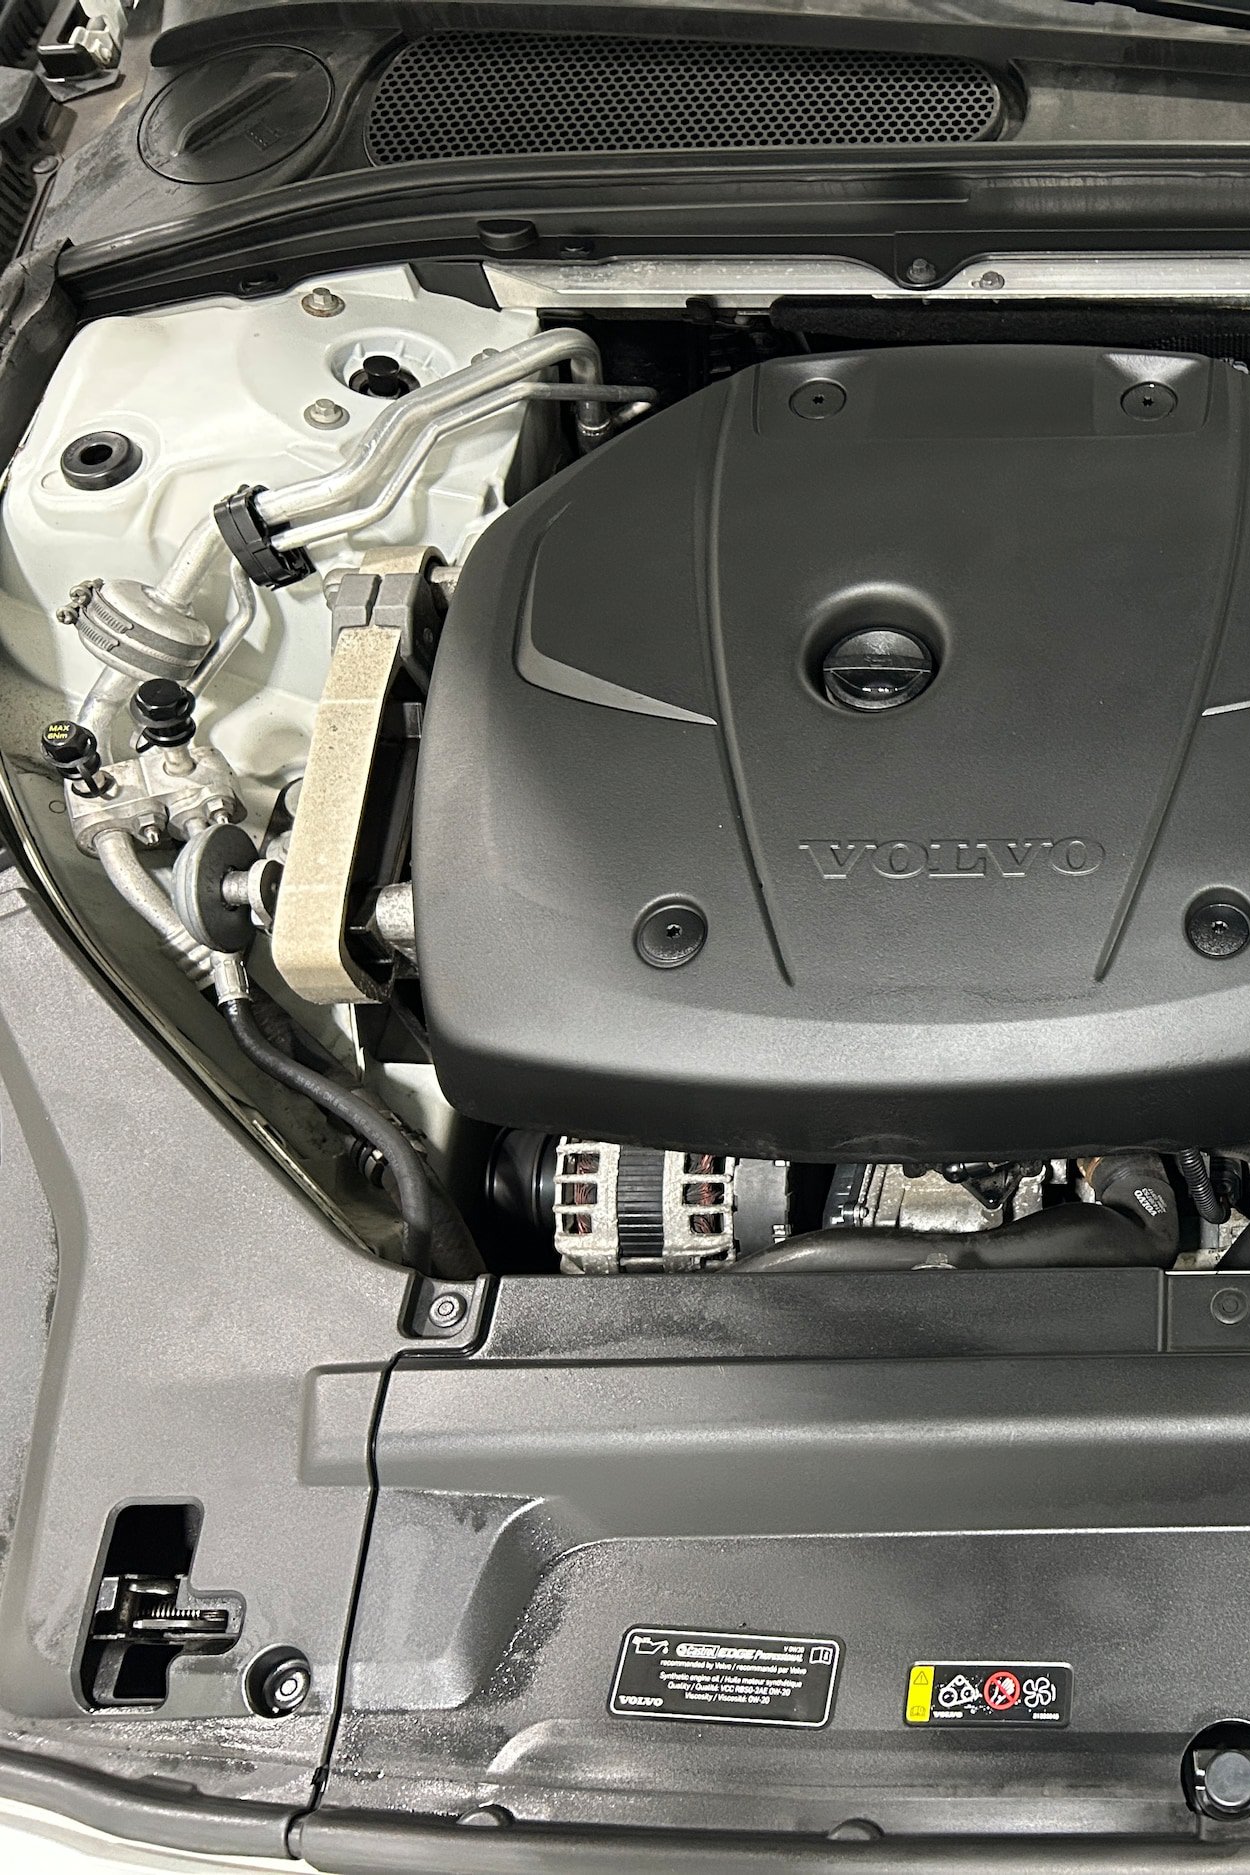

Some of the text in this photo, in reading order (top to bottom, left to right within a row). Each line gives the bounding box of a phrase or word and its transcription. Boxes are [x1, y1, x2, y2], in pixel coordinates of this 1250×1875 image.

[799, 837, 1106, 879] VOLVO
[1134, 1190, 1157, 1216] VOLVO
[686, 1645, 717, 1657] Castrol
[717, 1647, 757, 1659] EDGE
[660, 1659, 706, 1669] recommended
[706, 1662, 714, 1671] by
[714, 1662, 732, 1670] Volvo
[777, 1667, 789, 1675] par
[789, 1667, 807, 1675] Volvo
[659, 1671, 690, 1681] Synthetic
[689, 1674, 711, 1683] engine
[741, 1678, 765, 1686] moteur
[667, 1681, 691, 1691] Quality
[720, 1684, 734, 1693] VCC
[768, 1688, 791, 1697] 0W-20
[618, 1694, 664, 1707] VOLVO
[685, 1692, 713, 1702] Viscosity
[747, 1696, 771, 1705] 0W-20
[933, 1711, 963, 1719] VOLVO
